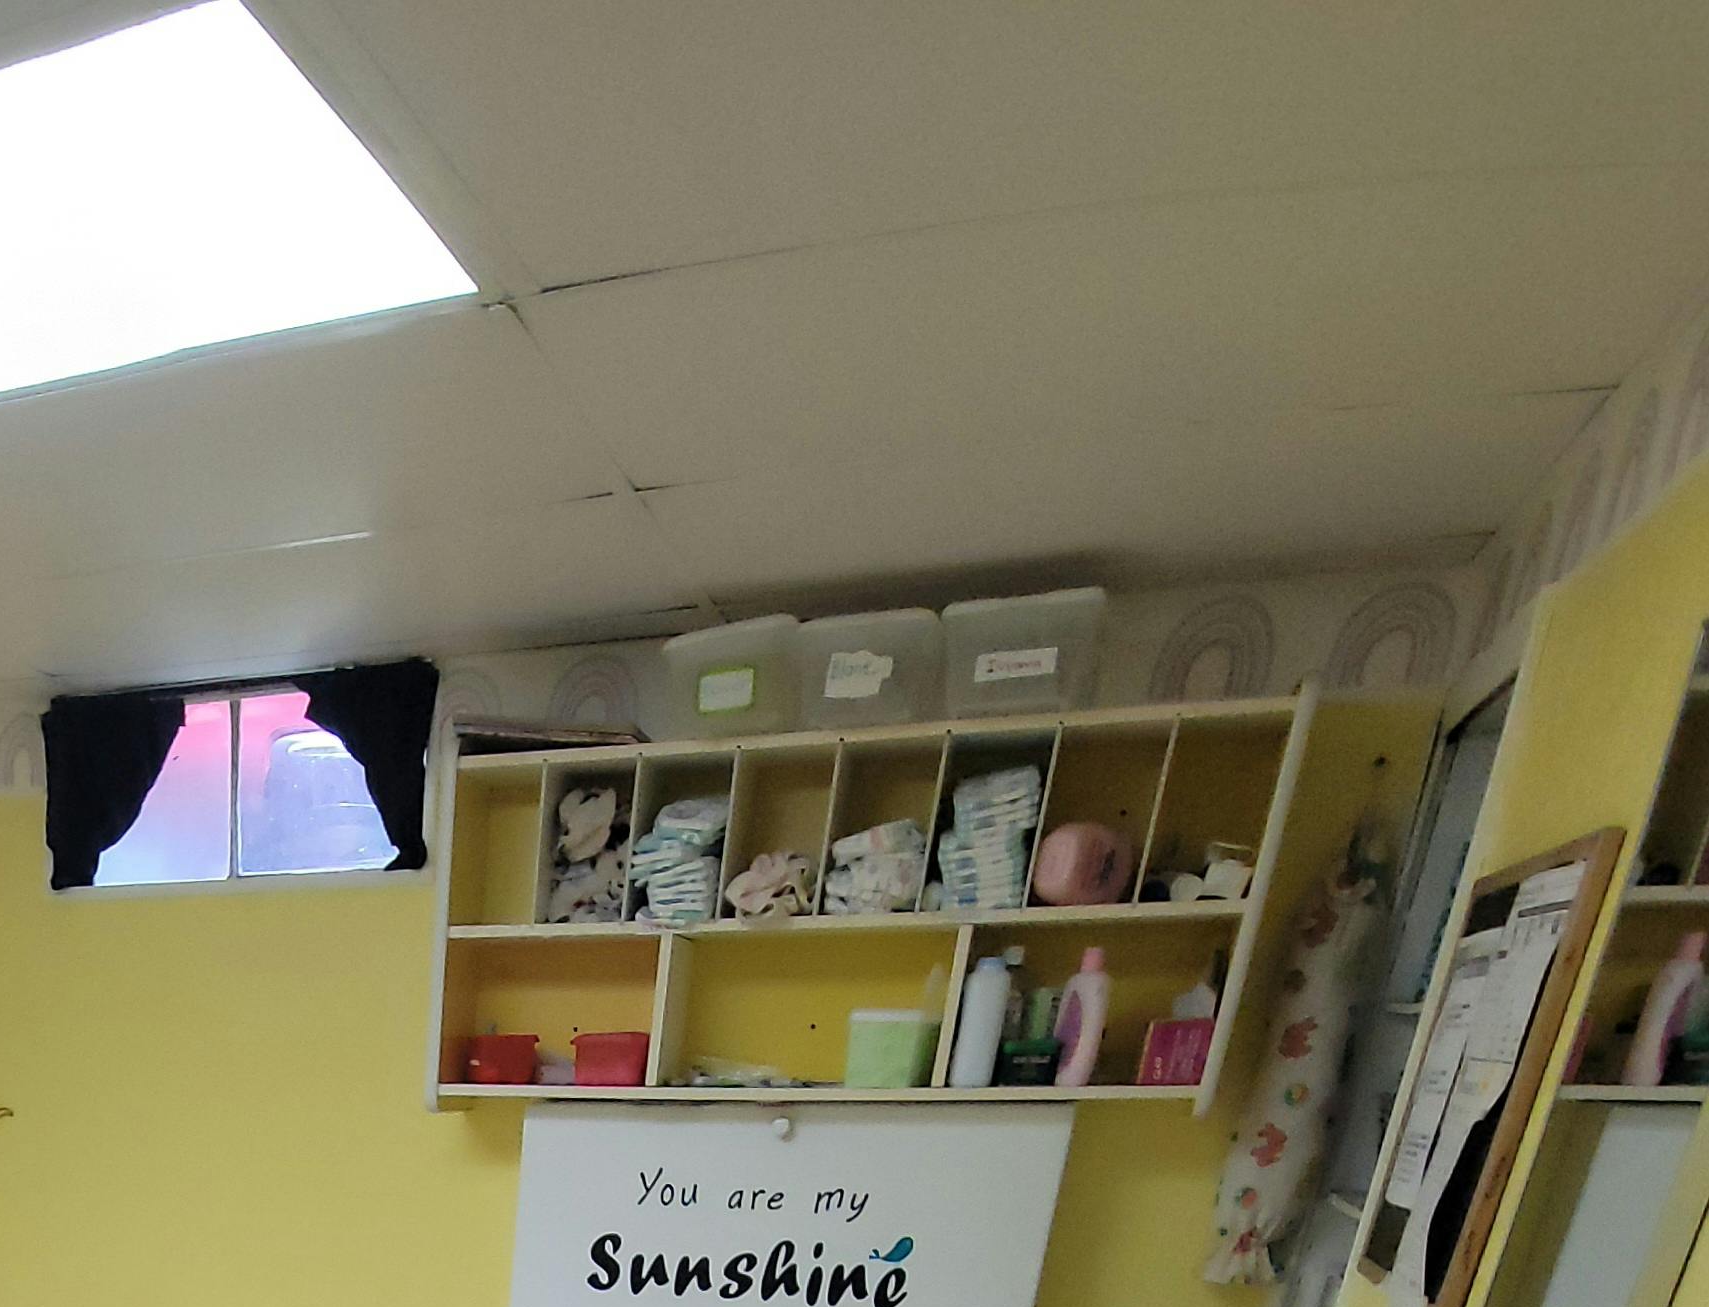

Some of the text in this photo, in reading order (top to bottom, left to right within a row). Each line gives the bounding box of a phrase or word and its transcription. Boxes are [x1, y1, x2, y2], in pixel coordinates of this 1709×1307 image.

[637, 1167, 869, 1222] You are my
